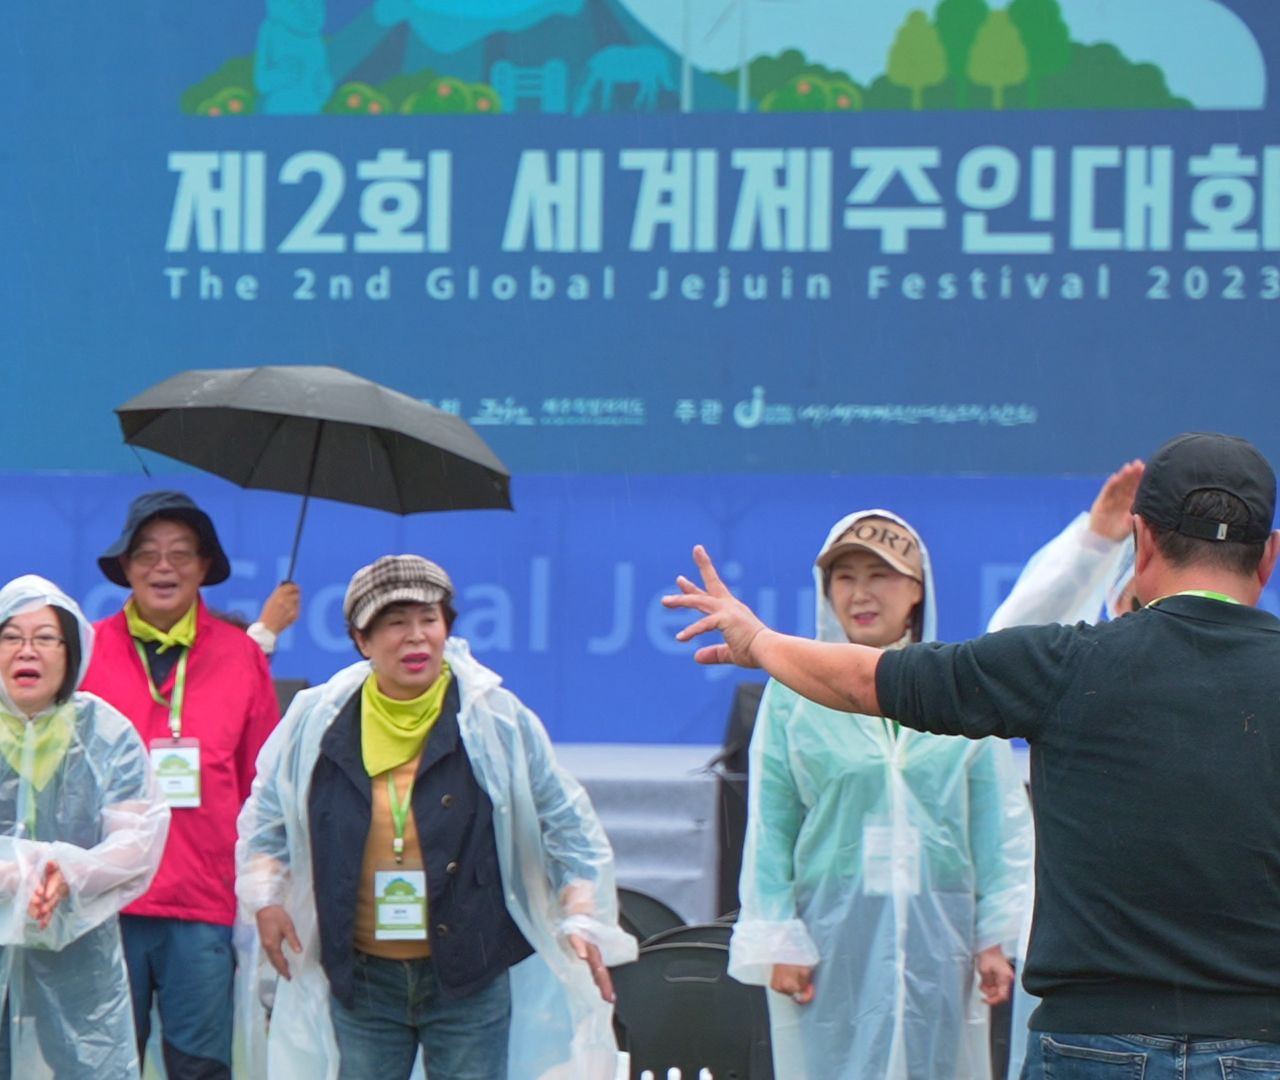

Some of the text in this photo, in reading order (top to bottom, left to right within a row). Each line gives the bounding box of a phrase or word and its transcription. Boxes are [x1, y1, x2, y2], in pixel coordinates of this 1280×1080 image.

[165, 145, 1280, 254] 제2회 세계제주인대회
[164, 265, 1280, 307] The 2nd Global Jejuin Festival 2023
